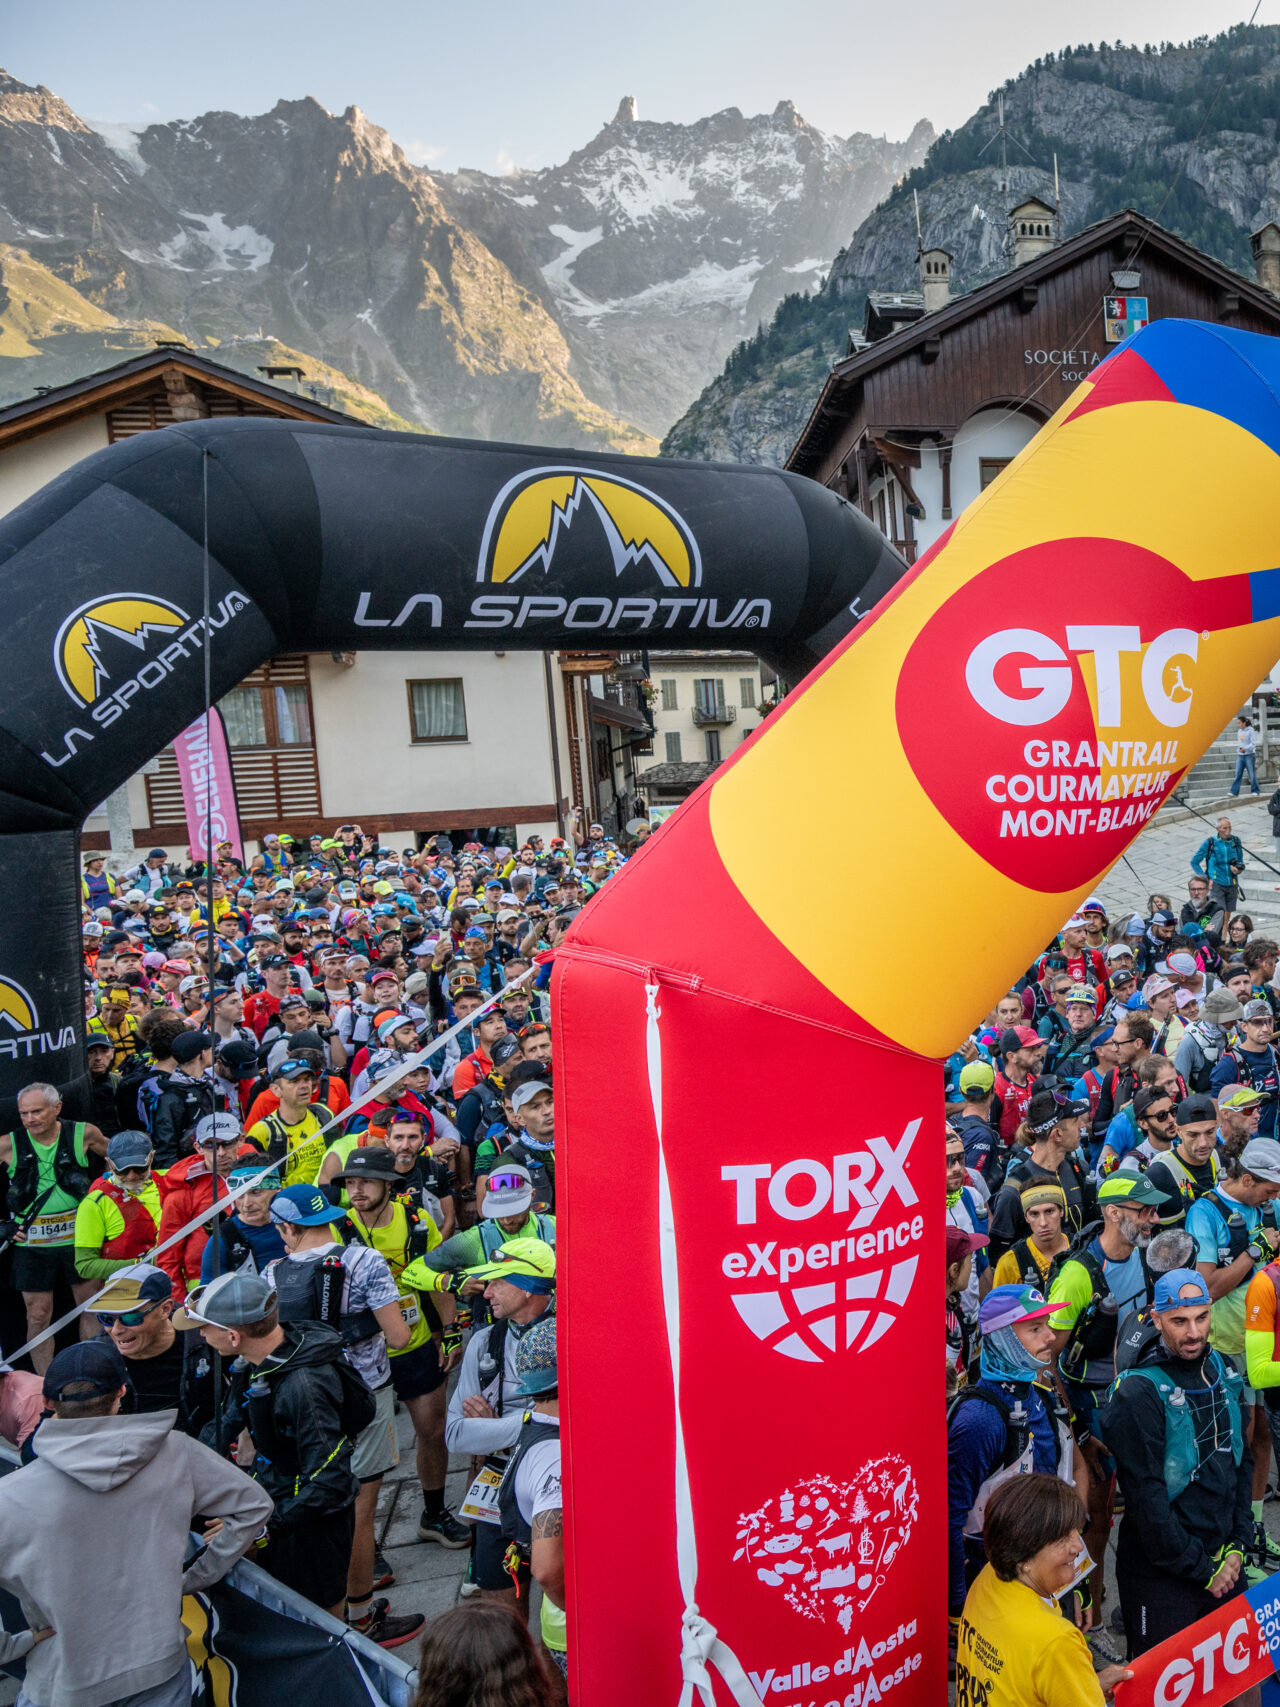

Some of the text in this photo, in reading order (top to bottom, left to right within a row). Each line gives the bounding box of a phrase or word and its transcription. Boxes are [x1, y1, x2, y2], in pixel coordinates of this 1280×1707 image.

[354, 592, 772, 629] LA SPORTIVA
[40, 590, 250, 768] LA SPORTIVA
[966, 625, 1198, 727] GTC
[1024, 740, 1178, 768] GRANTRAIL
[986, 771, 1172, 803] COURMAYEUR
[1000, 796, 1160, 838] MONT-BLANC
[721, 1117, 923, 1231] TORX
[40, 1225, 68, 1236] 1544
[722, 1215, 923, 1283] eXperience
[321, 1273, 332, 1321] SALOMON
[748, 1619, 917, 1703] Valle d'Aosta
[842, 1652, 923, 1707] d'Aoste
[1154, 1617, 1251, 1707] GTC
